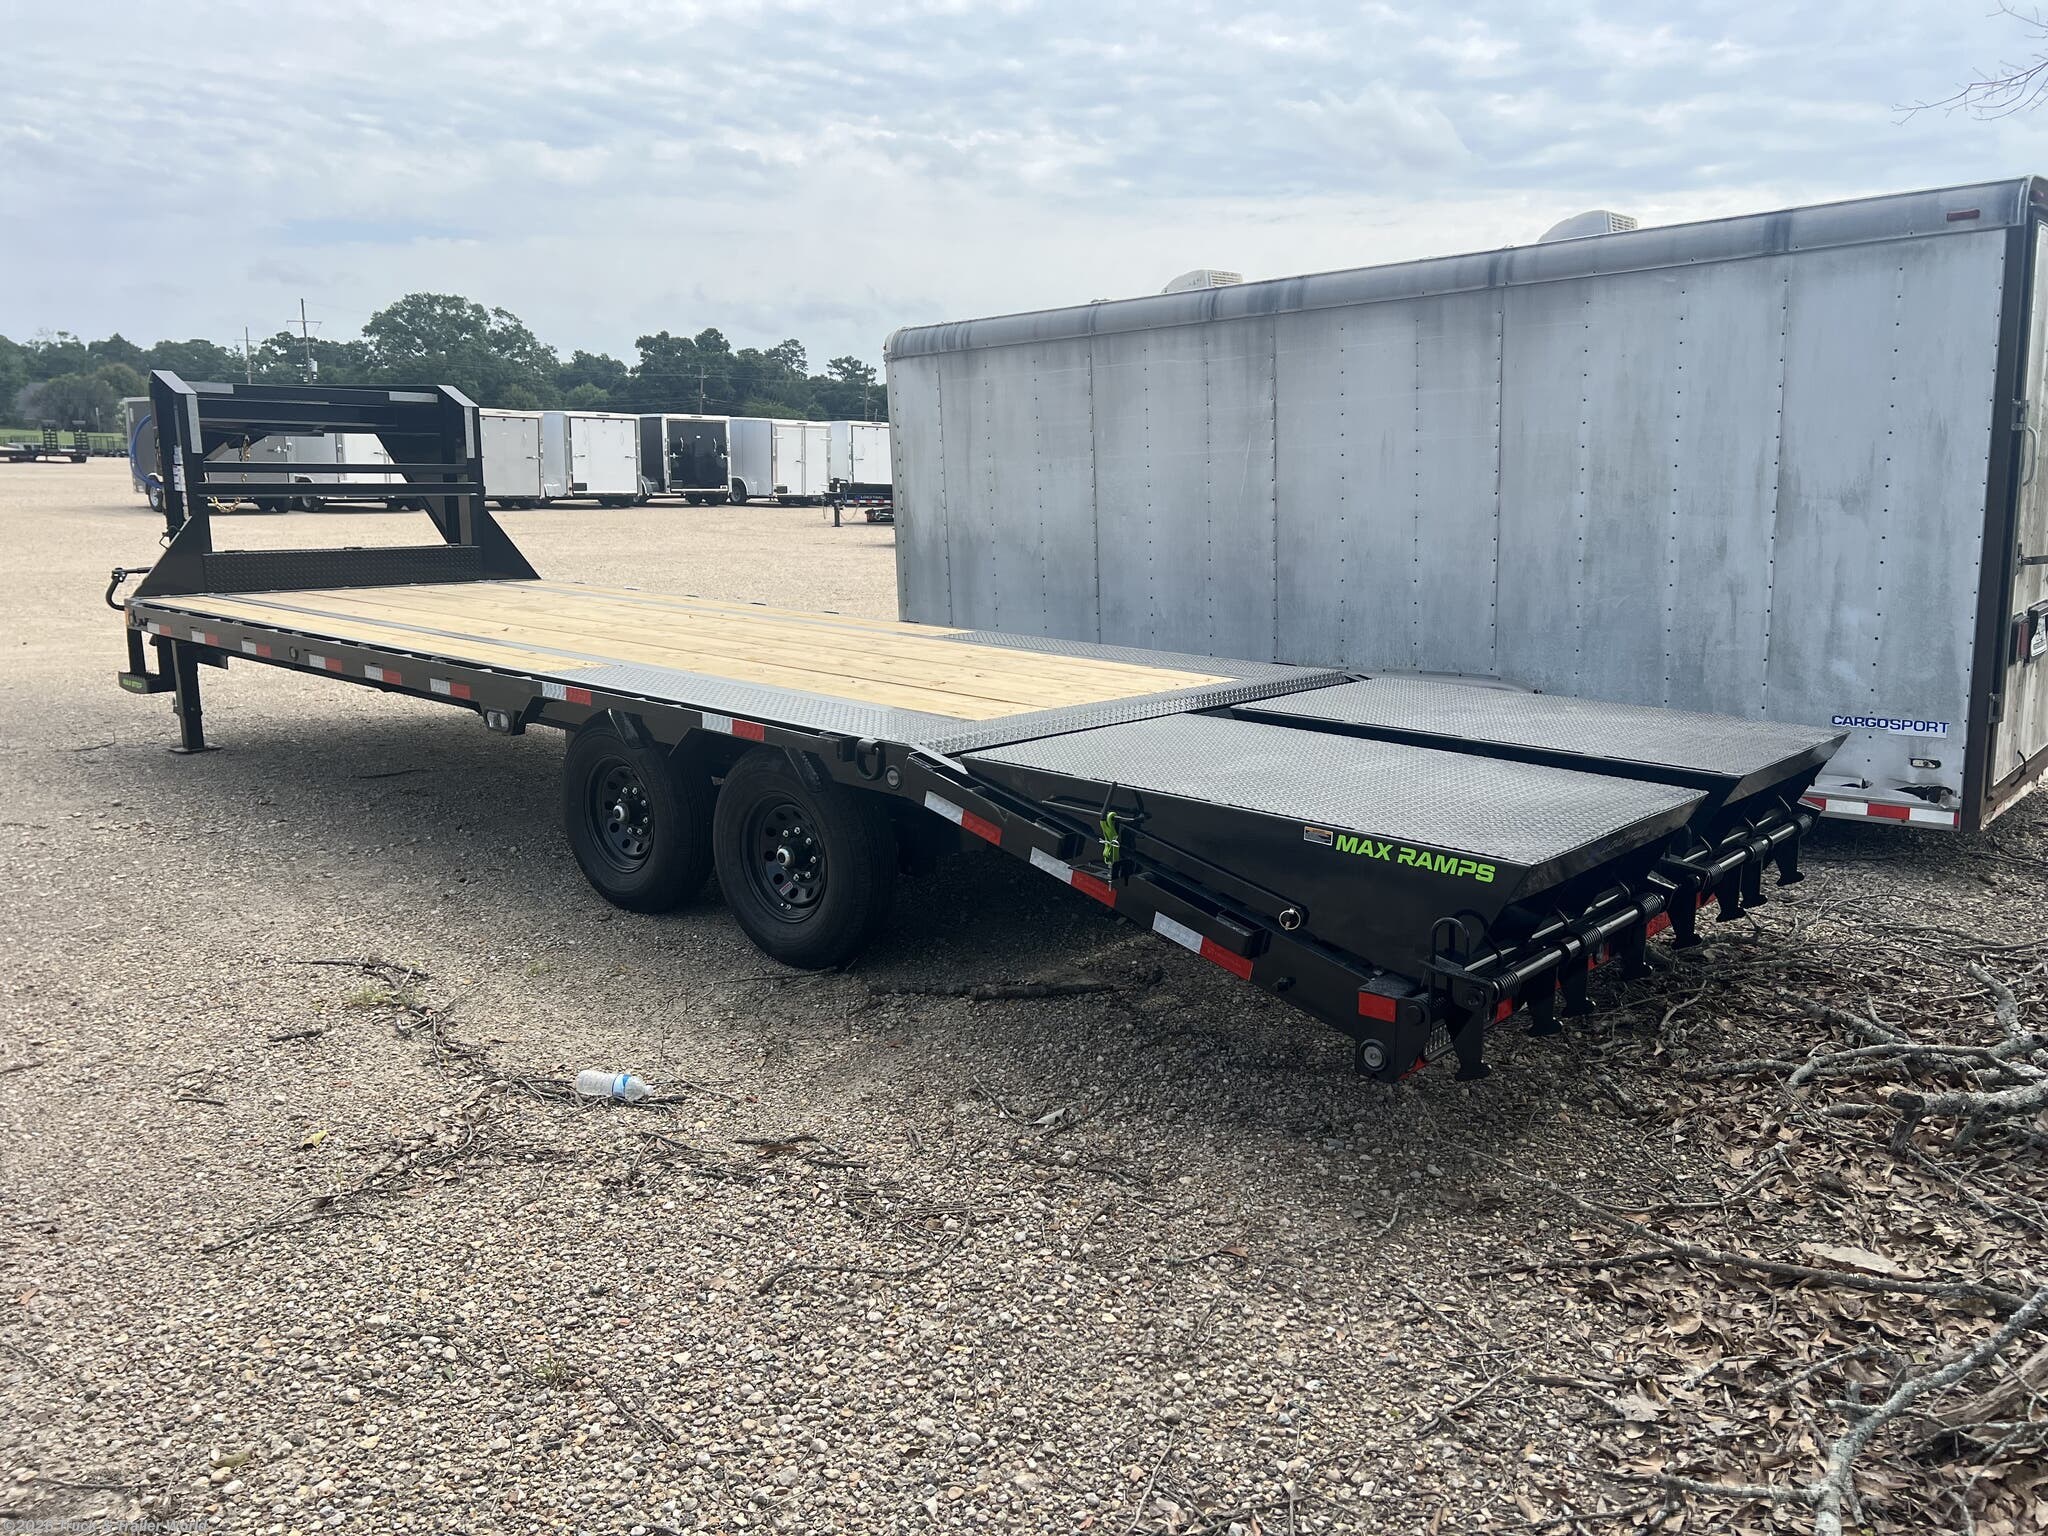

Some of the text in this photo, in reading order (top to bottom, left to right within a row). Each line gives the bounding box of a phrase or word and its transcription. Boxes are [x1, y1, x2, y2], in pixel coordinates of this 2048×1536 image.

[1831, 714, 1950, 734] CARGOSPORT
[1335, 834, 1394, 861] MAX
[1397, 847, 1497, 883] RAMPS
